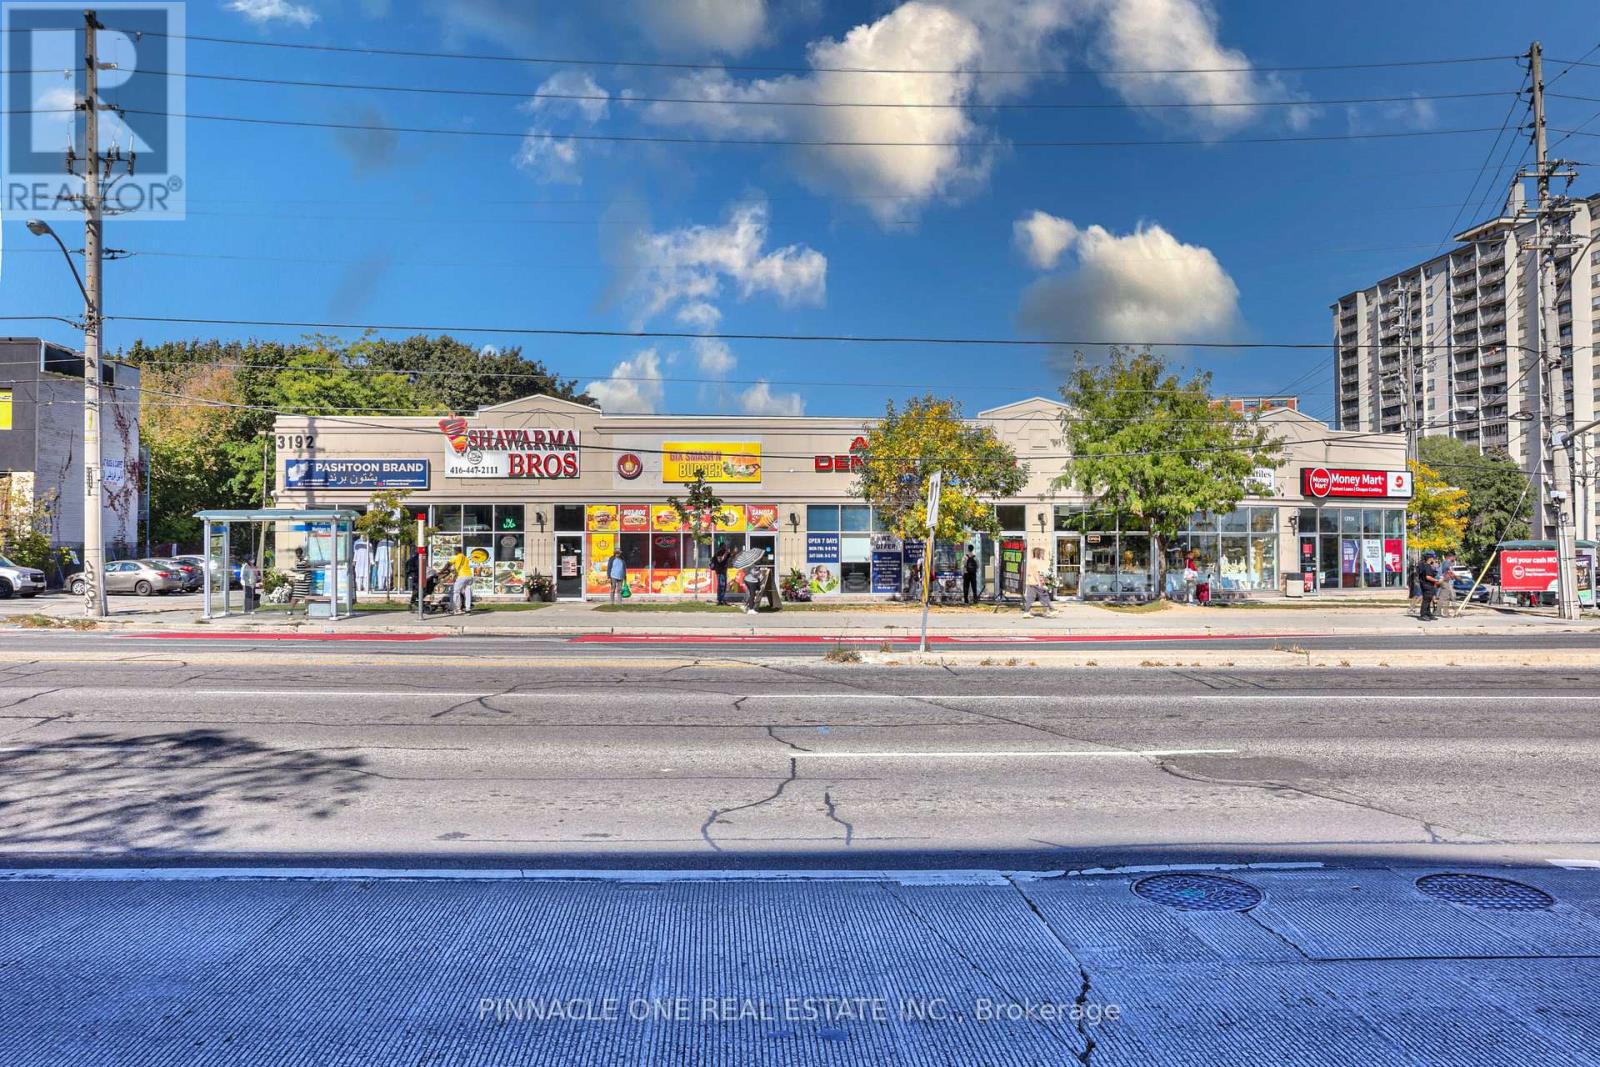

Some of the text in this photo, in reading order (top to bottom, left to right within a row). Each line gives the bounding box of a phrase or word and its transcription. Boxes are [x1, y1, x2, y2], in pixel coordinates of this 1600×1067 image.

[277, 435, 314, 449] 3192
[467, 429, 578, 451] SHAWARMA
[315, 463, 424, 472] PASHTOON BRAND
[449, 466, 498, 475] 416-447-2111
[508, 452, 578, 479] BROS
[1254, 469, 1272, 478] tiles
[1312, 476, 1329, 484] Money
[1331, 473, 1383, 486] Money Mart
